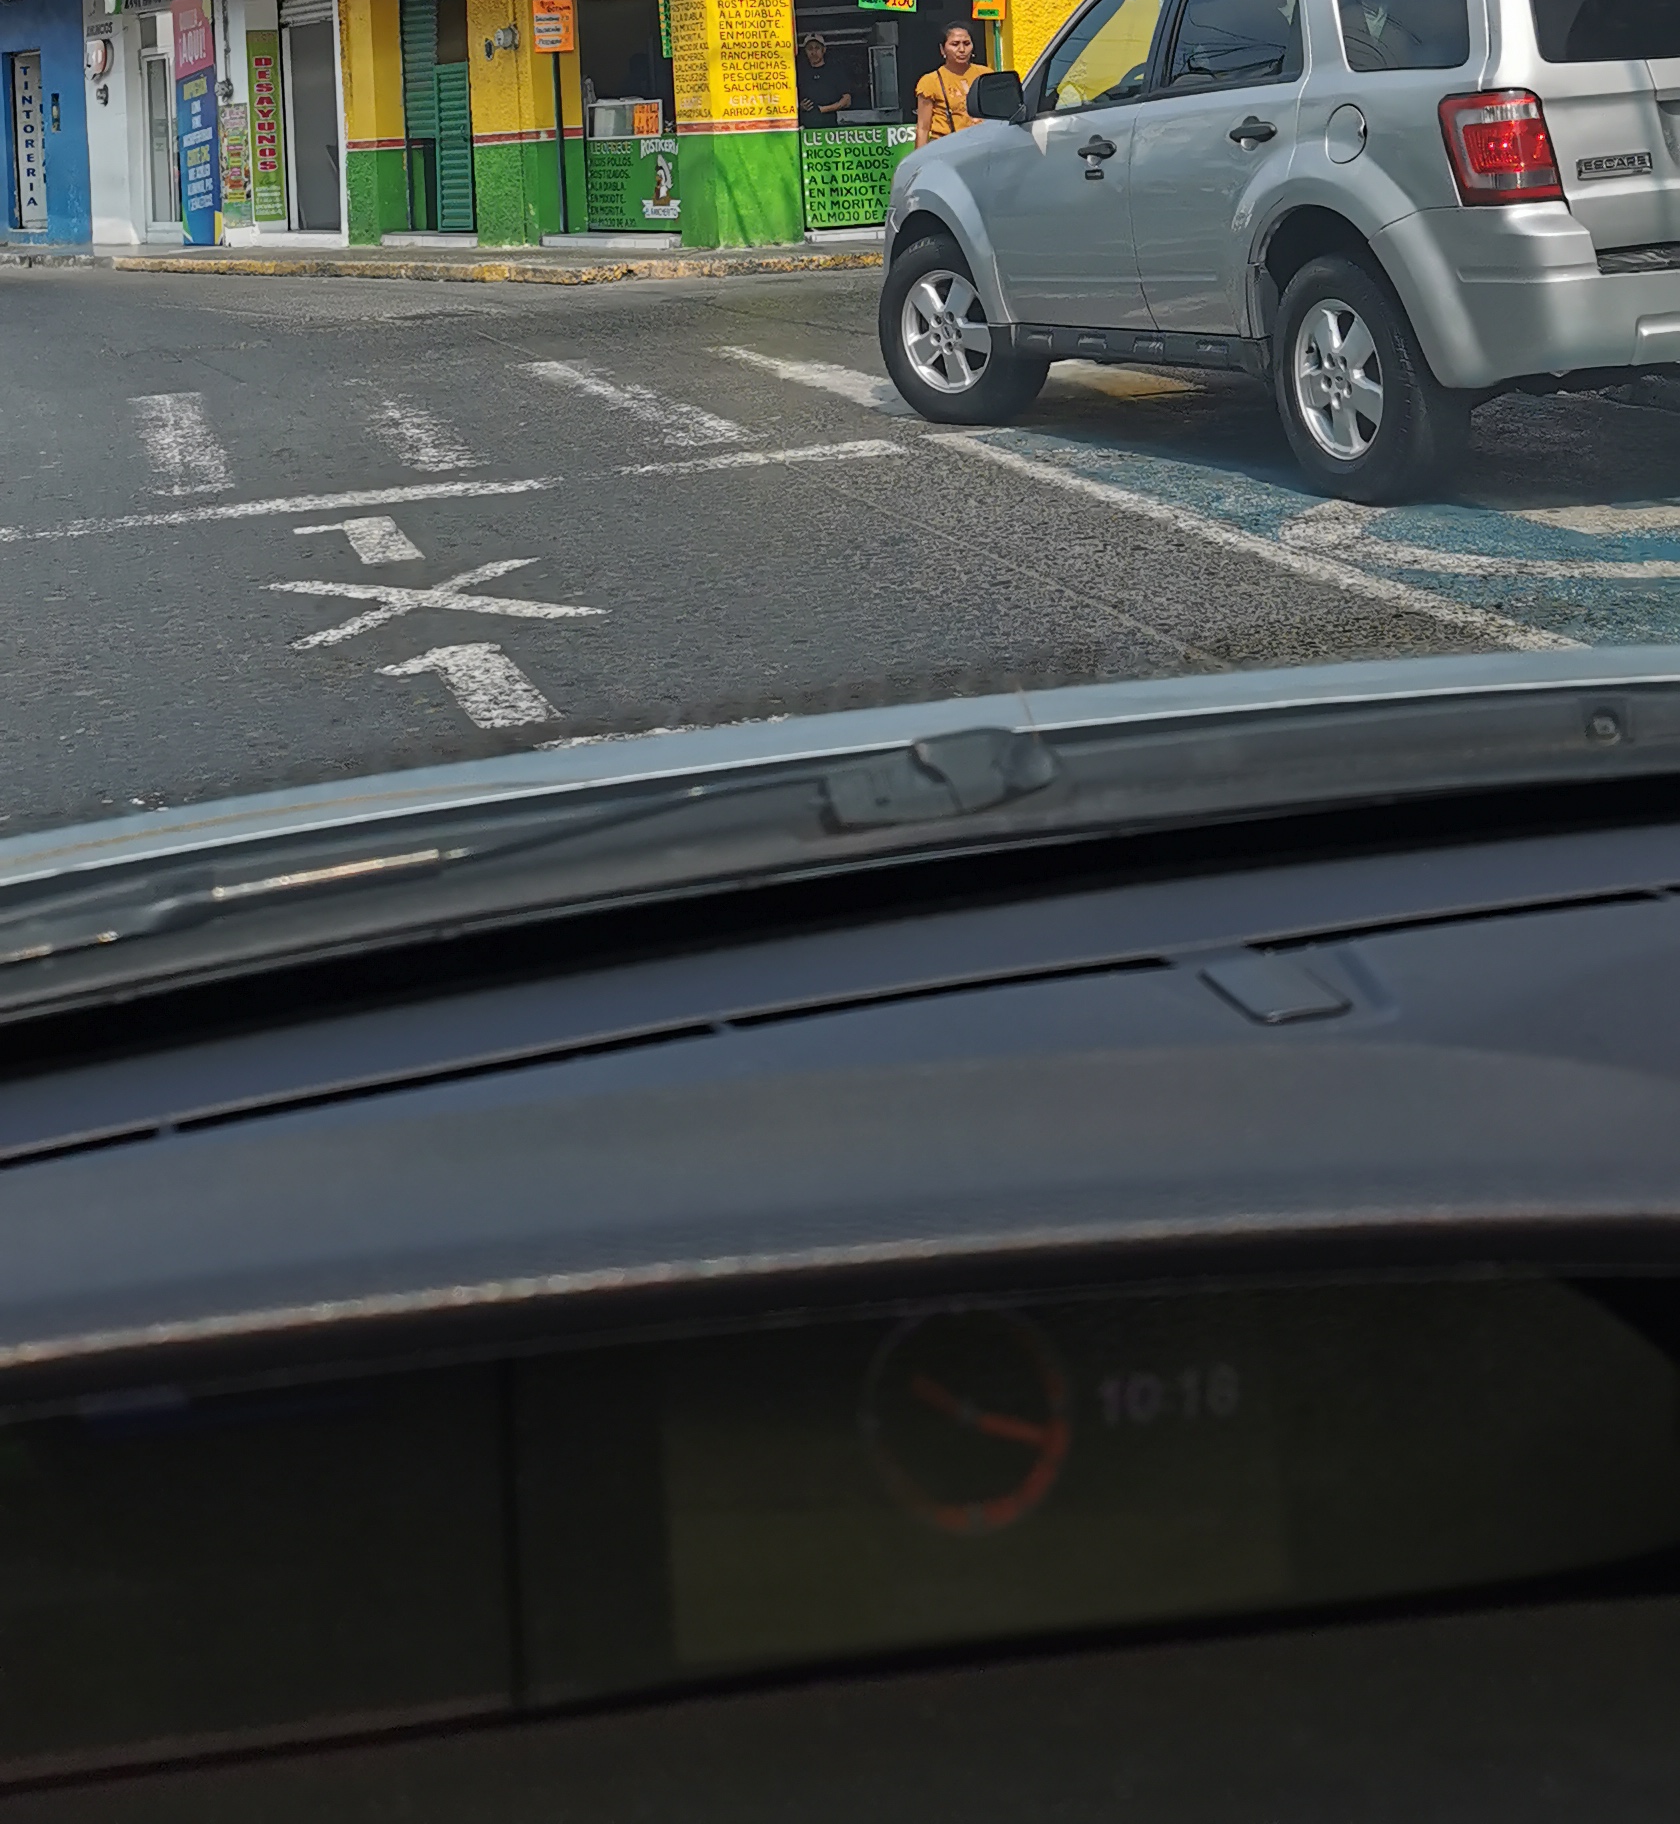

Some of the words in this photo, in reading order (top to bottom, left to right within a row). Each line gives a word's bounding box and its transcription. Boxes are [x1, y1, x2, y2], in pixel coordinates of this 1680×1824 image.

[719, 10, 726, 19] A
[728, 10, 741, 18] LA
[745, 8, 785, 18] DIABLA.
[719, 21, 732, 30] EN
[735, 20, 784, 29] MIXIOTE.
[720, 31, 734, 41] EN
[736, 30, 780, 40] MORITA.
[721, 42, 759, 50] ALMOJO
[761, 41, 772, 49] DE
[775, 41, 792, 49] AJO
[720, 50, 784, 60] RANCHEROS.
[721, 60, 791, 71] SALCHICHAS.
[723, 71, 789, 82] PESCUEZOS.
[729, 93, 780, 106] GRATIS
[253, 55, 278, 172] DESAYUNOS
[722, 106, 756, 117] ARROZ
[757, 107, 764, 115] Y
[766, 105, 796, 115] SALSA
[20, 65, 38, 207] TINTORERIA
[803, 131, 822, 146] LE
[825, 128, 882, 145] OFRECE
[806, 148, 841, 159] RICOS
[844, 145, 894, 158] POLLOS.
[807, 159, 893, 172] ROSTIZADOS.
[1584, 155, 1647, 171] ESCAPE
[809, 175, 817, 185] A
[821, 175, 838, 185] LA
[842, 171, 891, 183] DIABLA.
[809, 188, 825, 198] EN
[830, 184, 891, 197] MIXIOTE.
[810, 200, 826, 212] EN
[830, 198, 888, 211] MORITA.
[811, 210, 860, 223] ALMOJO
[865, 210, 878, 221] DE
